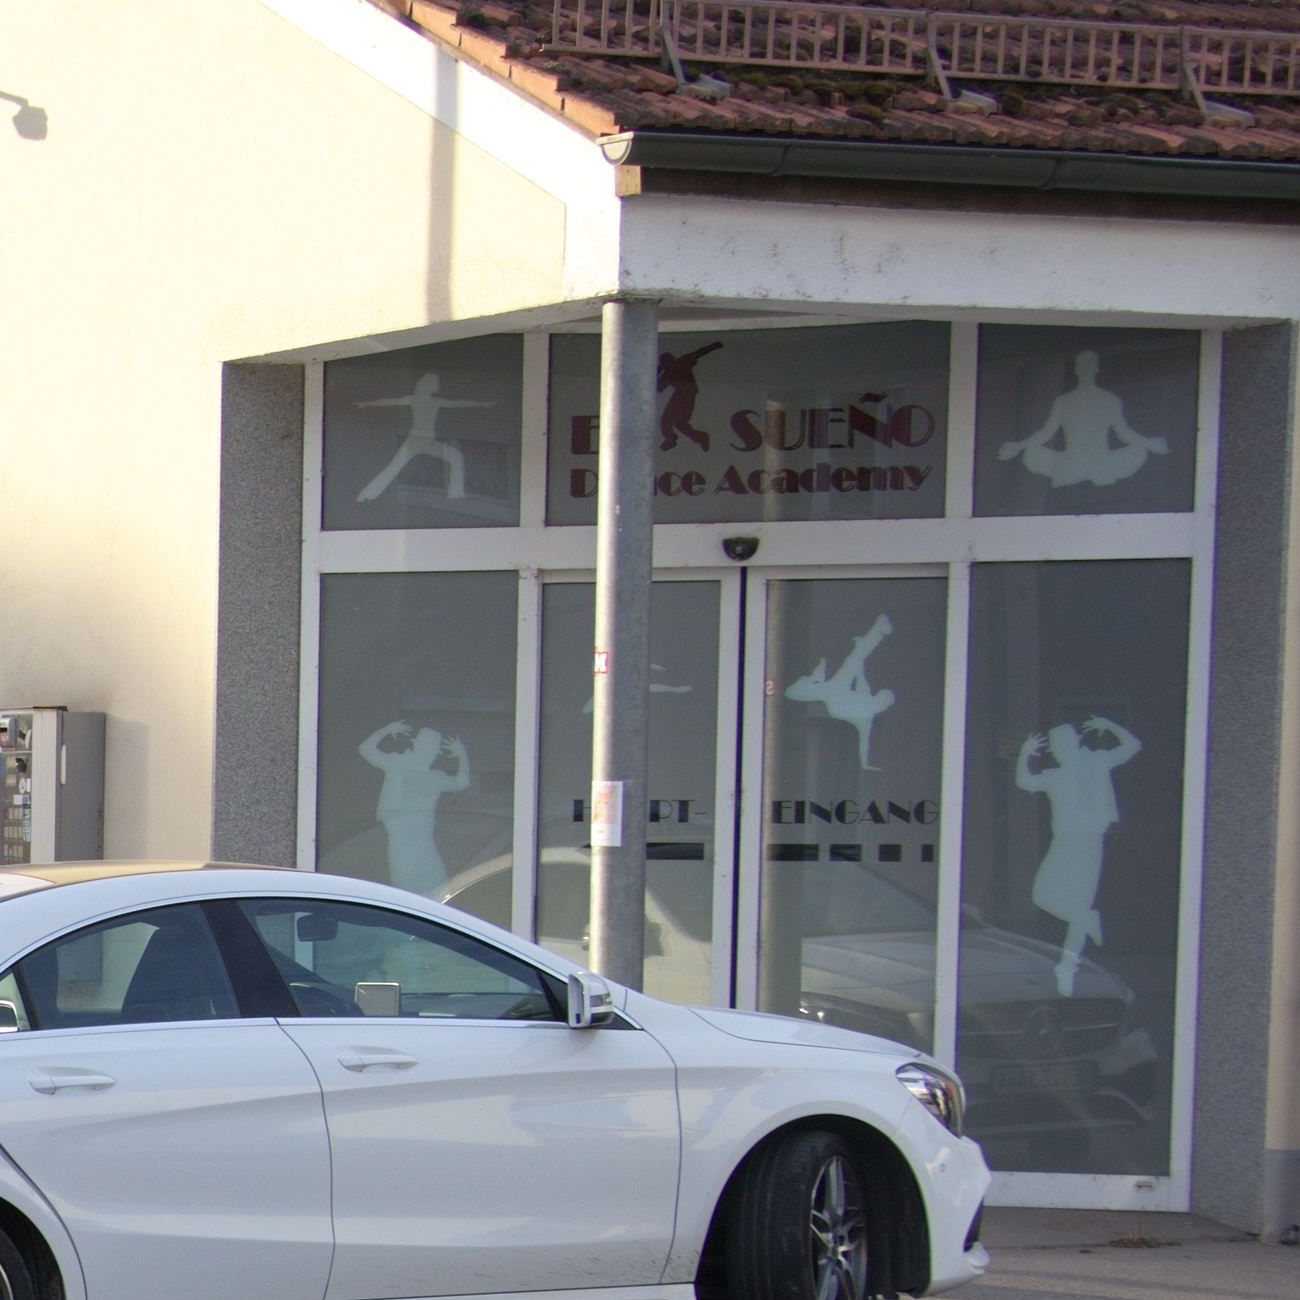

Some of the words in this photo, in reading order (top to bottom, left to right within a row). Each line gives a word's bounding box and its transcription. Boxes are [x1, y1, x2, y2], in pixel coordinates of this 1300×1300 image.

[730, 391, 935, 452] SUEÑO
[570, 468, 706, 498] Dce
[713, 463, 934, 495] Academy
[770, 800, 939, 825] EINGANG
